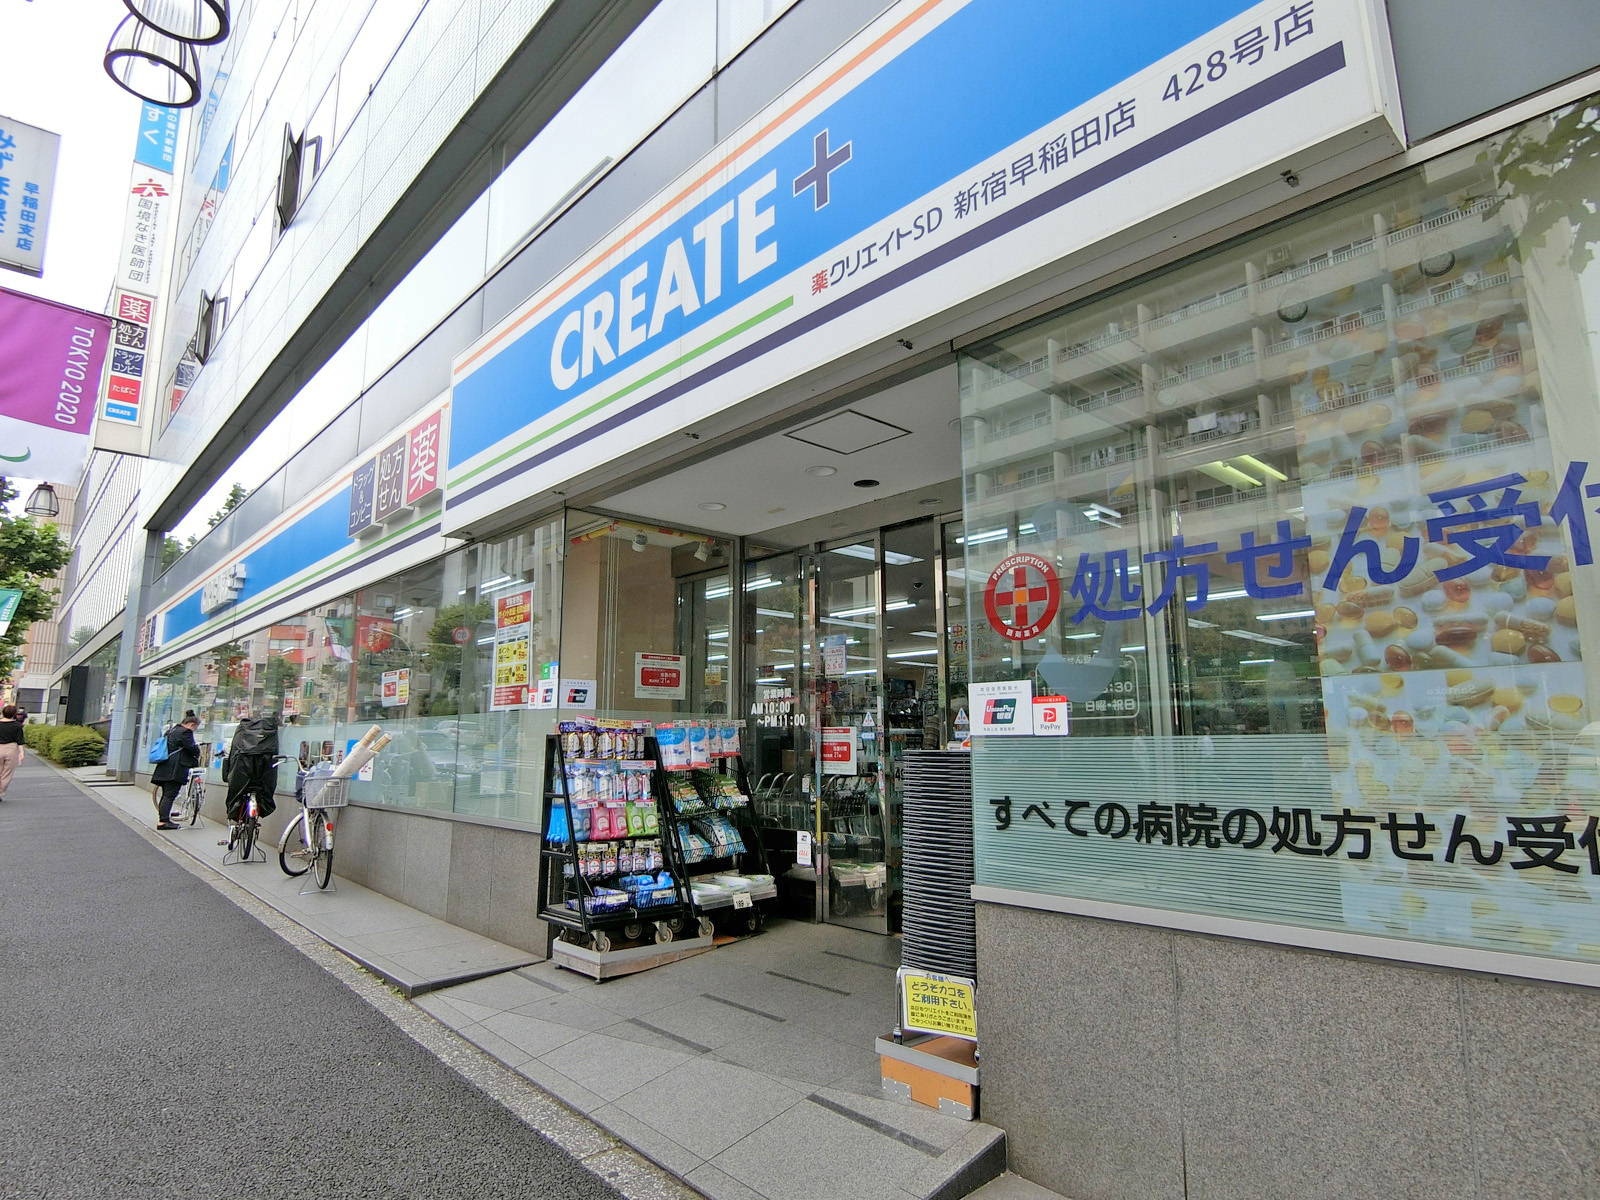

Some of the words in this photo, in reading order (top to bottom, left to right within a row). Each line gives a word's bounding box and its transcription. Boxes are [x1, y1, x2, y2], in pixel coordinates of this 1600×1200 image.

[953, 97, 1136, 219] 新宿早稲田店
[1162, 1, 1314, 102] 428号店
[16, 181, 40, 251] 早稲田支店
[128, 198, 153, 282] 国境なき医師団
[550, 168, 777, 390] CREATE
[121, 297, 149, 322] 薬
[117, 333, 145, 348] せん
[118, 323, 146, 338] 処方
[65, 325, 96, 382] TOKYO
[114, 349, 143, 362] ドラッグ
[113, 363, 142, 377] コンビニ
[112, 384, 137, 396] たばこ
[54, 380, 83, 426] 2020
[107, 406, 131, 417] CREATE
[380, 445, 404, 486] 処方
[409, 423, 438, 495] 薬
[353, 464, 375, 494] ドラッグ
[379, 478, 401, 512] せん
[350, 502, 371, 528] コンビニ
[992, 556, 1049, 581] PRESCRIPTION
[763, 687, 792, 700] 営業時間
[986, 704, 1015, 716] UnionPay
[912, 993, 972, 1012] ご利用下さい。
